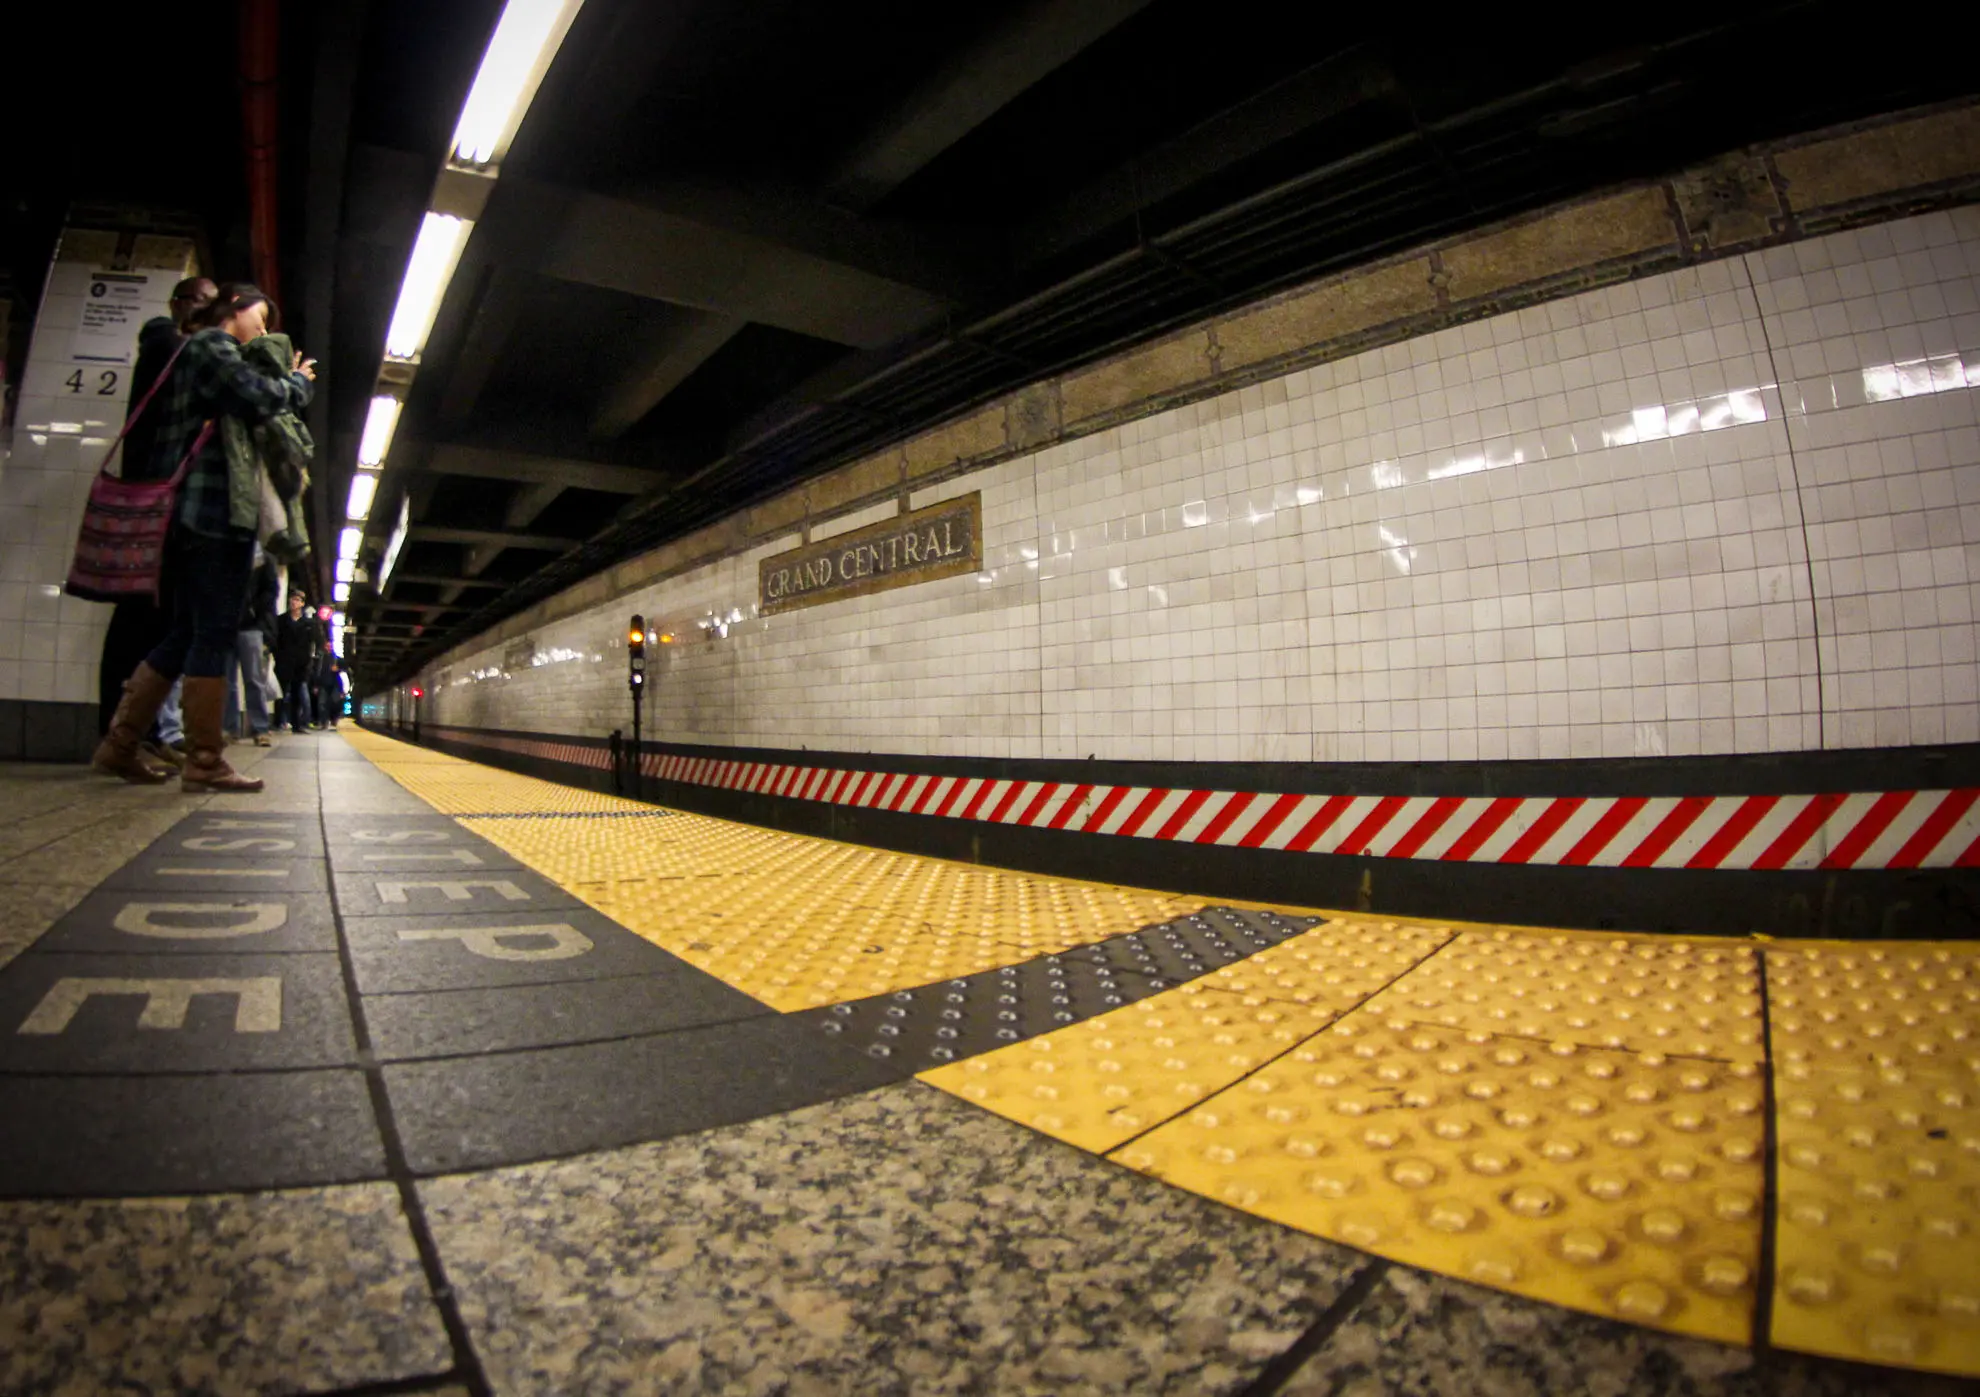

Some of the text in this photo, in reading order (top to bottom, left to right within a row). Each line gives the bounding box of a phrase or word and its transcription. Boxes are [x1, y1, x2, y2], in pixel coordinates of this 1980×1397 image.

[768, 522, 963, 598] GRAND CENTRAL
[17, 818, 296, 1034] ASIDE
[350, 829, 594, 962] STEP
